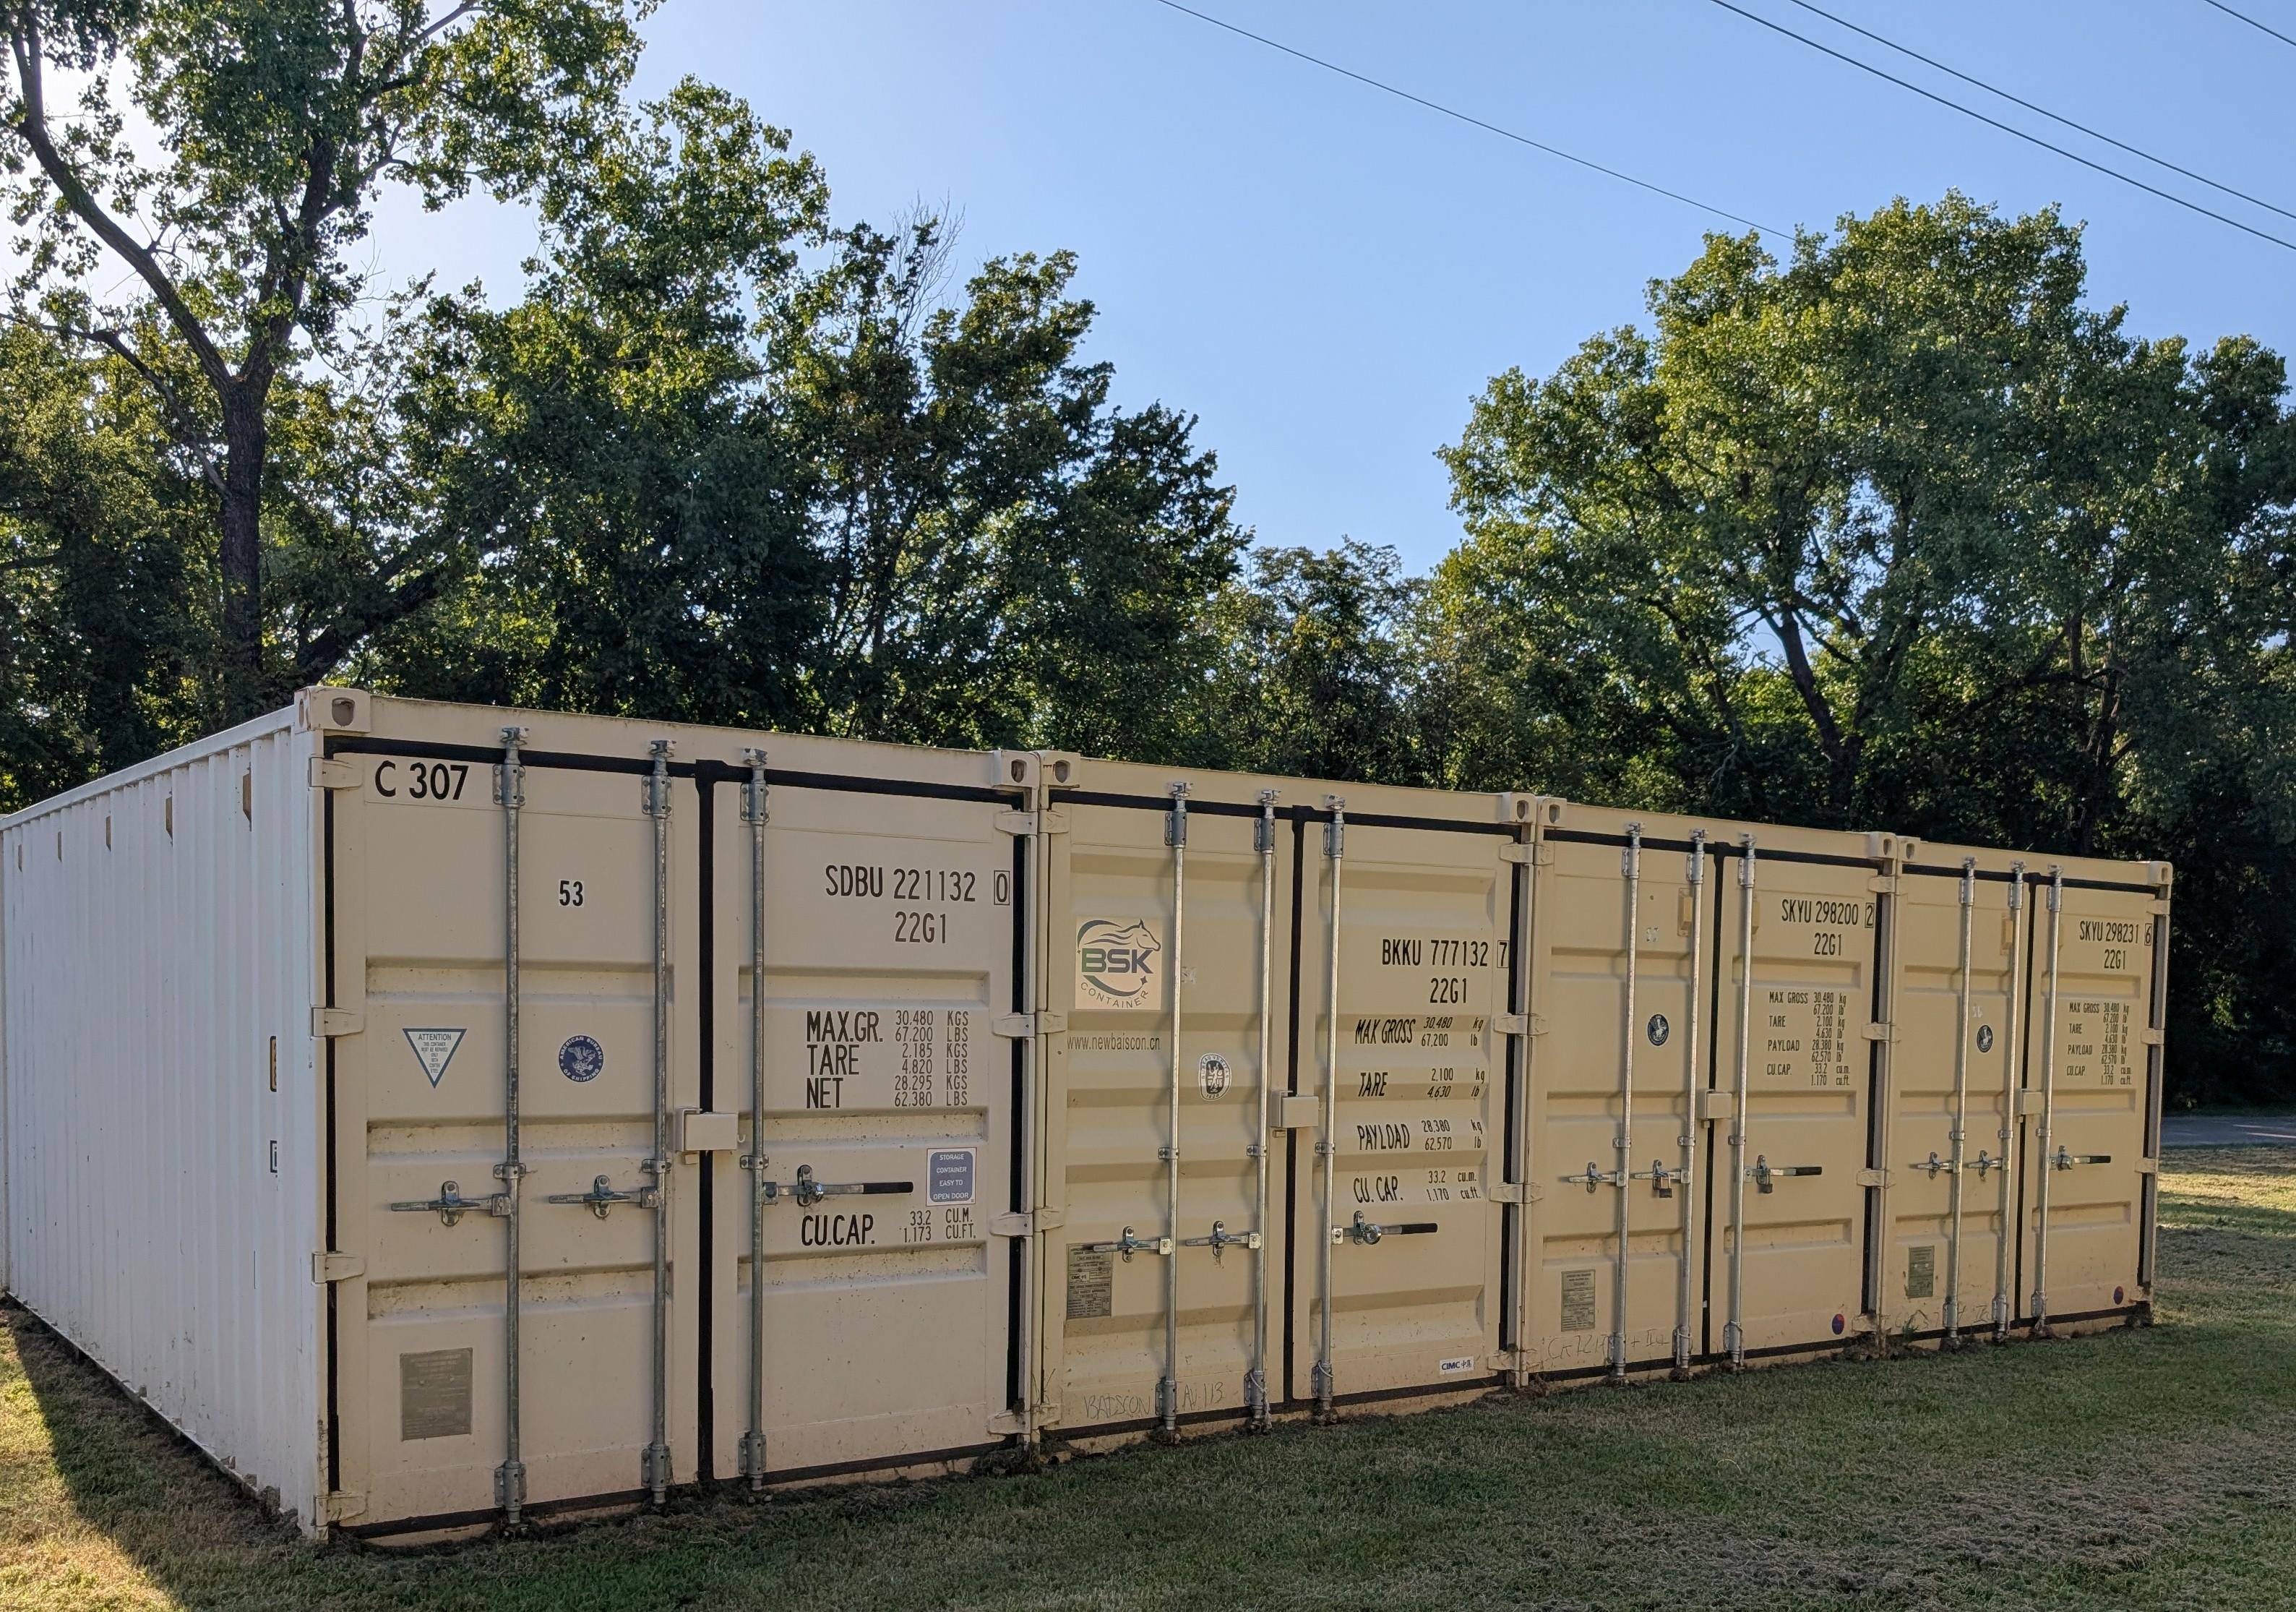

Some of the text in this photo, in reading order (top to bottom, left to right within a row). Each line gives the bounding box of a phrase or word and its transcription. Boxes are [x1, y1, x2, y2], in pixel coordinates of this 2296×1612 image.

[375, 760, 469, 801] C 307
[559, 880, 583, 906] 53
[825, 865, 883, 898] SDBU
[893, 868, 976, 903] 221132
[1781, 899, 1873, 926] SKYU 298200 2
[894, 911, 947, 944] 22G1
[2079, 920, 2151, 944] SKYU 298231 6
[1382, 938, 1508, 967] BKKU 777132 7
[1814, 933, 1841, 956] 22G1
[1081, 948, 1154, 974] BSK
[2104, 948, 2126, 969] 22G1
[1080, 982, 1148, 1009] CONTAINER
[1429, 977, 1467, 1004] 22G1
[1769, 992, 1784, 1003] MAX
[1788, 993, 1808, 1004] GROSS
[1839, 994, 1846, 1006] kg
[1839, 1006, 1844, 1015] lb
[2069, 1003, 2081, 1013] MAX
[2083, 1003, 2099, 1013] GROSS
[946, 1011, 969, 1026] KGS
[1769, 1016, 1786, 1027] TARE
[1838, 1017, 1845, 1029] kg
[946, 1026, 968, 1042] LBS
[1355, 1019, 1381, 1045] MAX
[1382, 1019, 1416, 1044] GROSS
[1473, 1017, 1484, 1032] kg
[1837, 1029, 1843, 1038] lb
[2069, 1024, 2082, 1034] TARE
[560, 1036, 603, 1060] AMERICAN BUREAU
[1470, 1034, 1478, 1047] lb
[1768, 1040, 1800, 1052] PAYLOAD
[1836, 1041, 1844, 1053] kg
[1836, 1052, 1842, 1062] lb
[2068, 1045, 2093, 1055] PAYLOAD
[807, 1045, 859, 1076] TARE
[946, 1044, 968, 1058] KGS
[946, 1060, 968, 1074] LBS
[571, 1068, 600, 1081] SHIPPING
[1358, 1071, 1388, 1097] TARE
[1475, 1068, 1485, 1084] kg
[807, 1078, 843, 1109] NET
[946, 1076, 968, 1091] KGS
[946, 1092, 968, 1107] LBS
[1471, 1086, 1480, 1097] lb
[1356, 1123, 1410, 1151] PAYLOAD
[1471, 1119, 1482, 1134] kg
[1474, 1136, 1482, 1149] lb
[1441, 1361, 1461, 1371] CIMC
